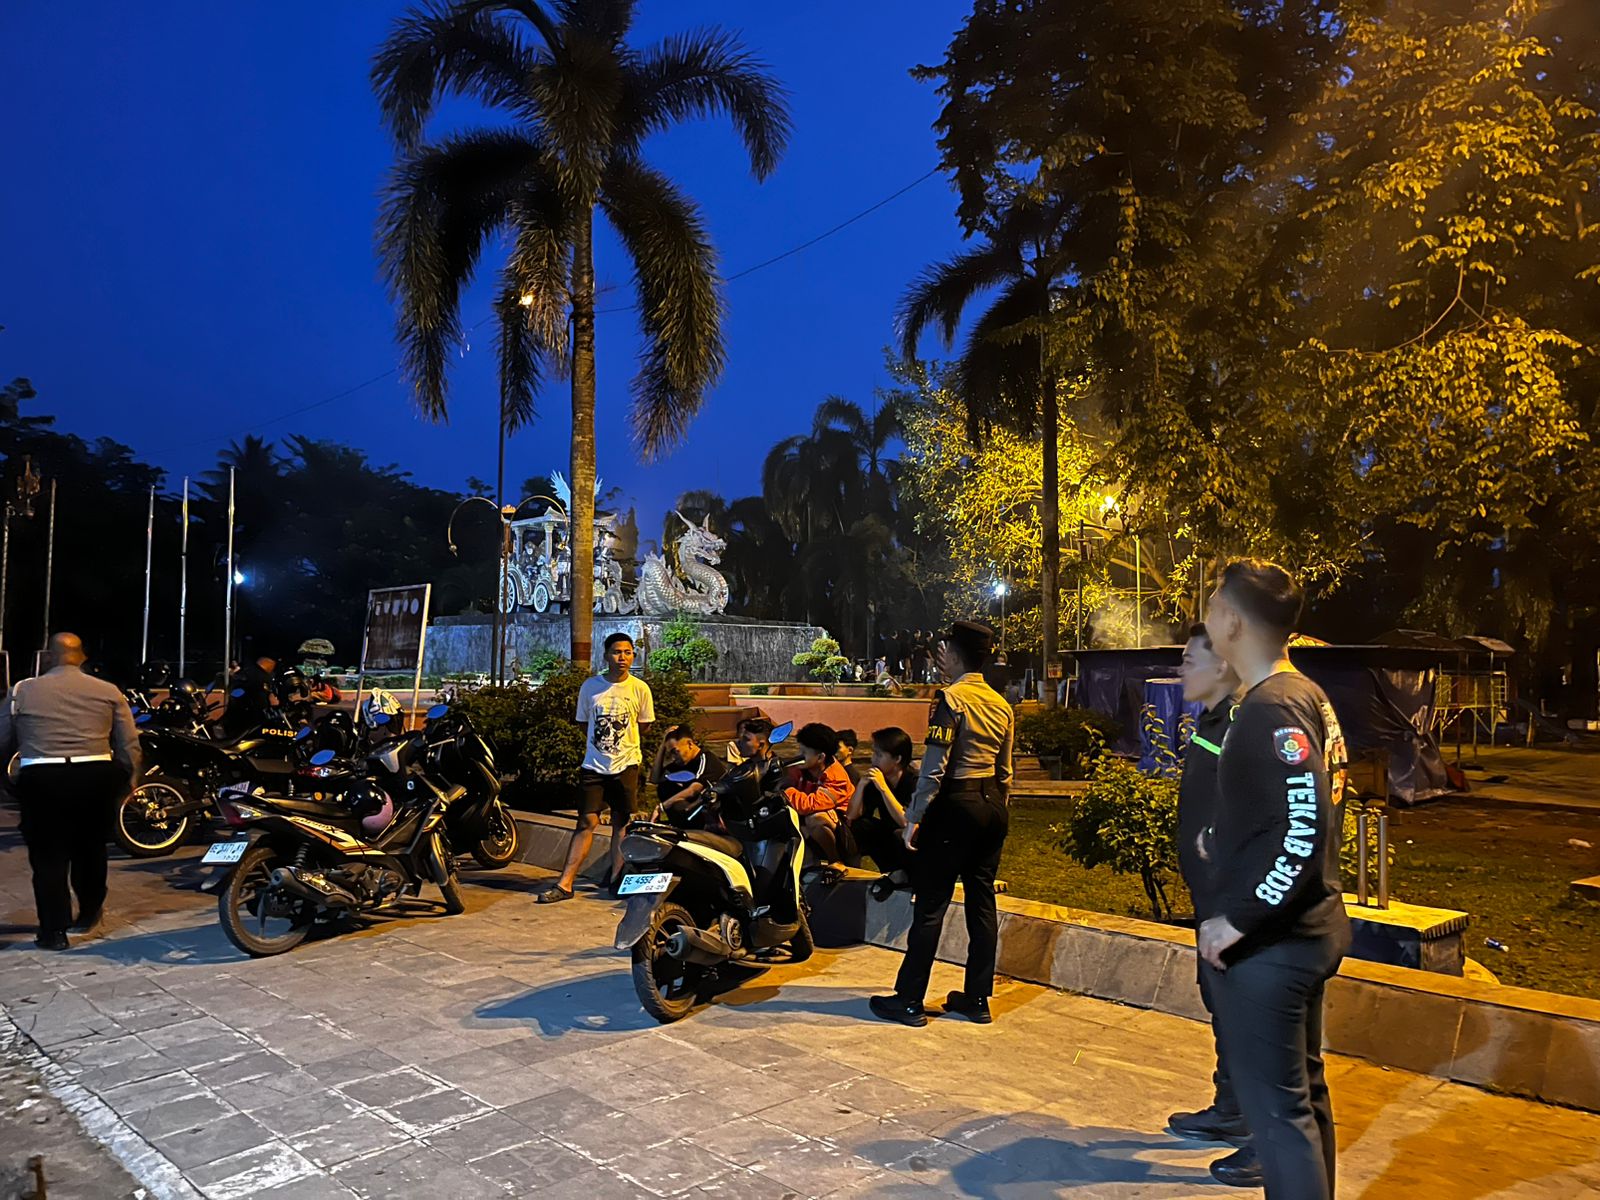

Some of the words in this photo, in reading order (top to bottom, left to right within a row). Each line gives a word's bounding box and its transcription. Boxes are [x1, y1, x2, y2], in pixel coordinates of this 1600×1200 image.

[1283, 772, 1317, 857] TEKAB
[623, 876, 634, 885] BE
[1255, 856, 1302, 905] 308
